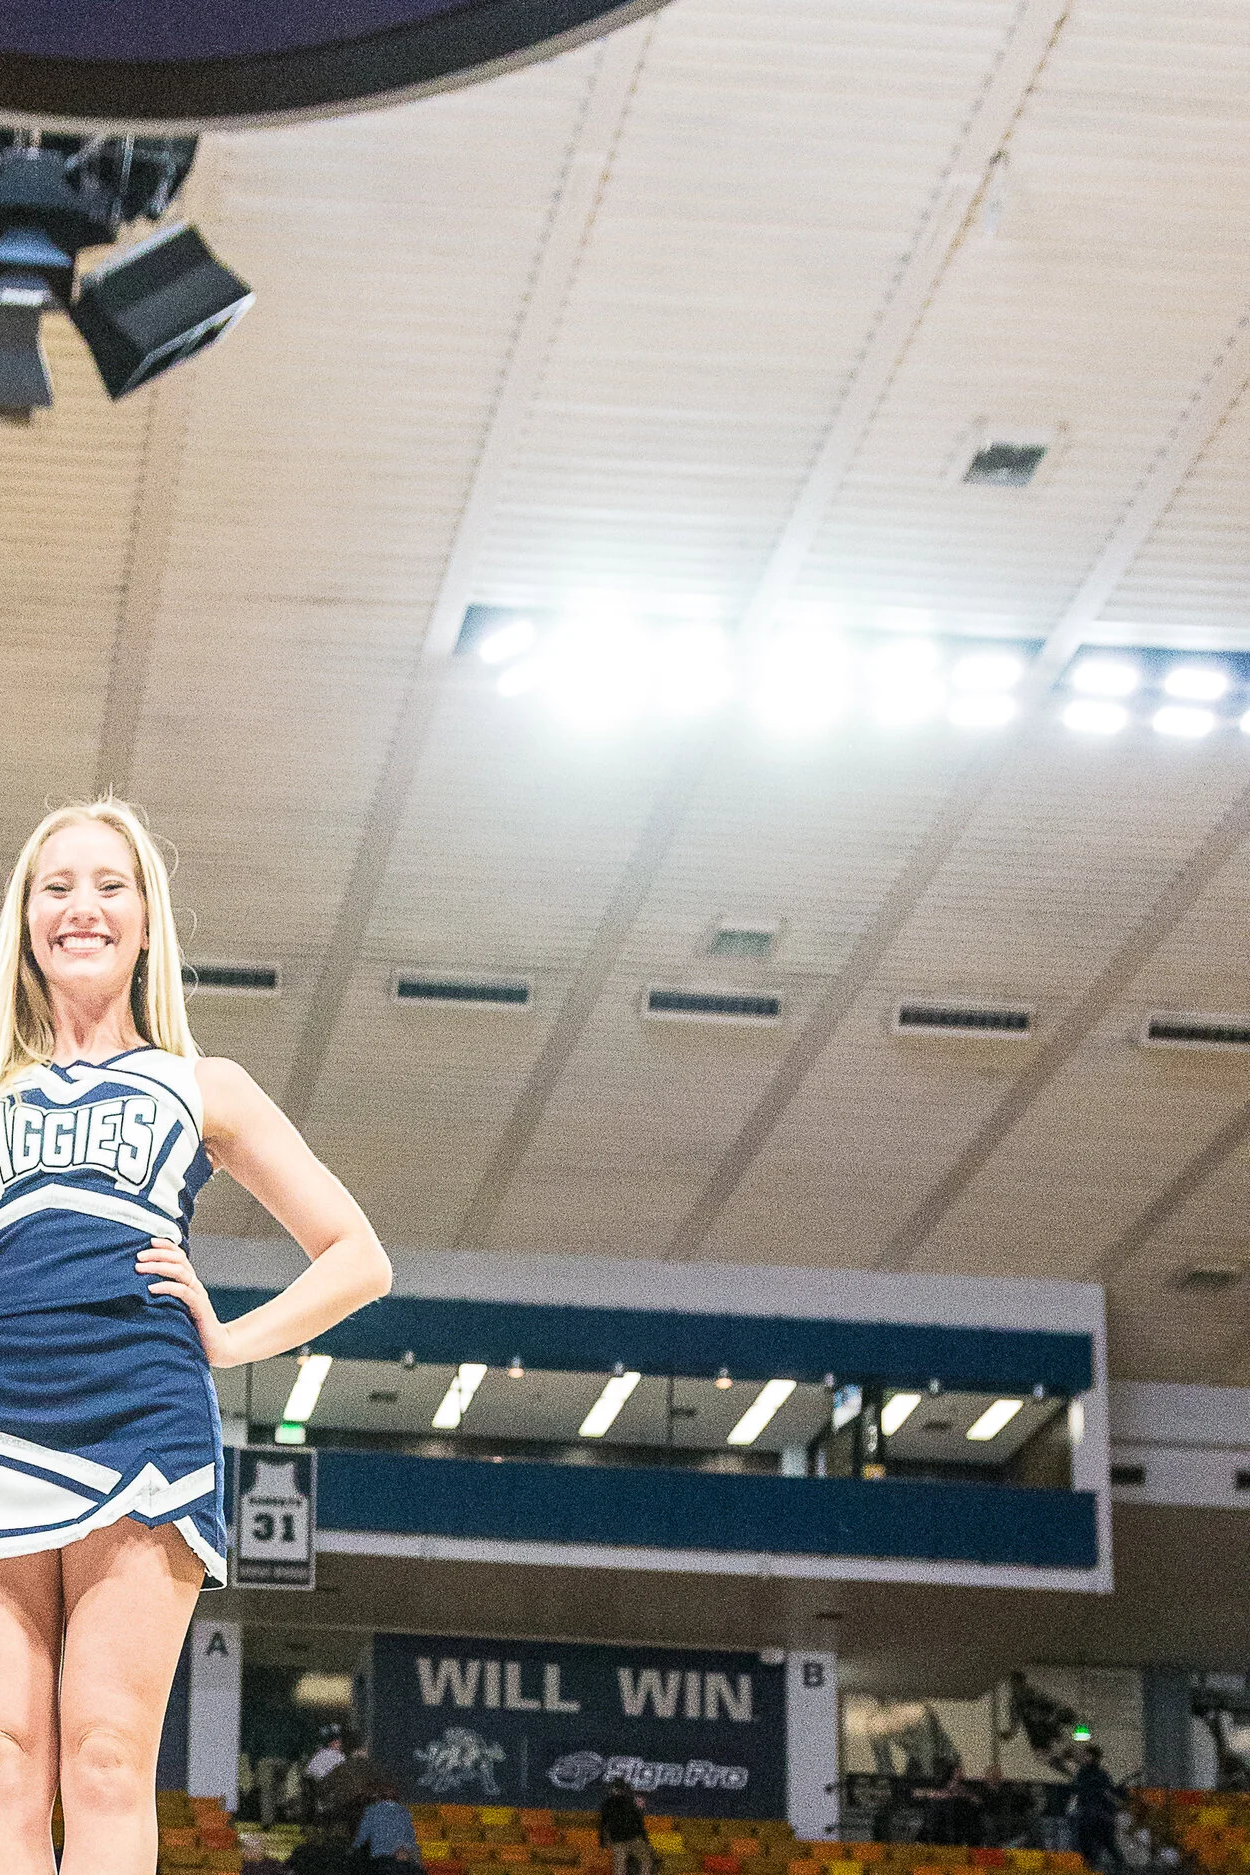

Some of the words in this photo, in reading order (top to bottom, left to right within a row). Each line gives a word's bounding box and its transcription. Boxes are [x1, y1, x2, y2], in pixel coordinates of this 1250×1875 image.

[253, 1512, 295, 1542] 31
[206, 1630, 228, 1658] A
[800, 1660, 827, 1688] B
[416, 1656, 581, 1713] WILL
[616, 1666, 753, 1722] WIN
